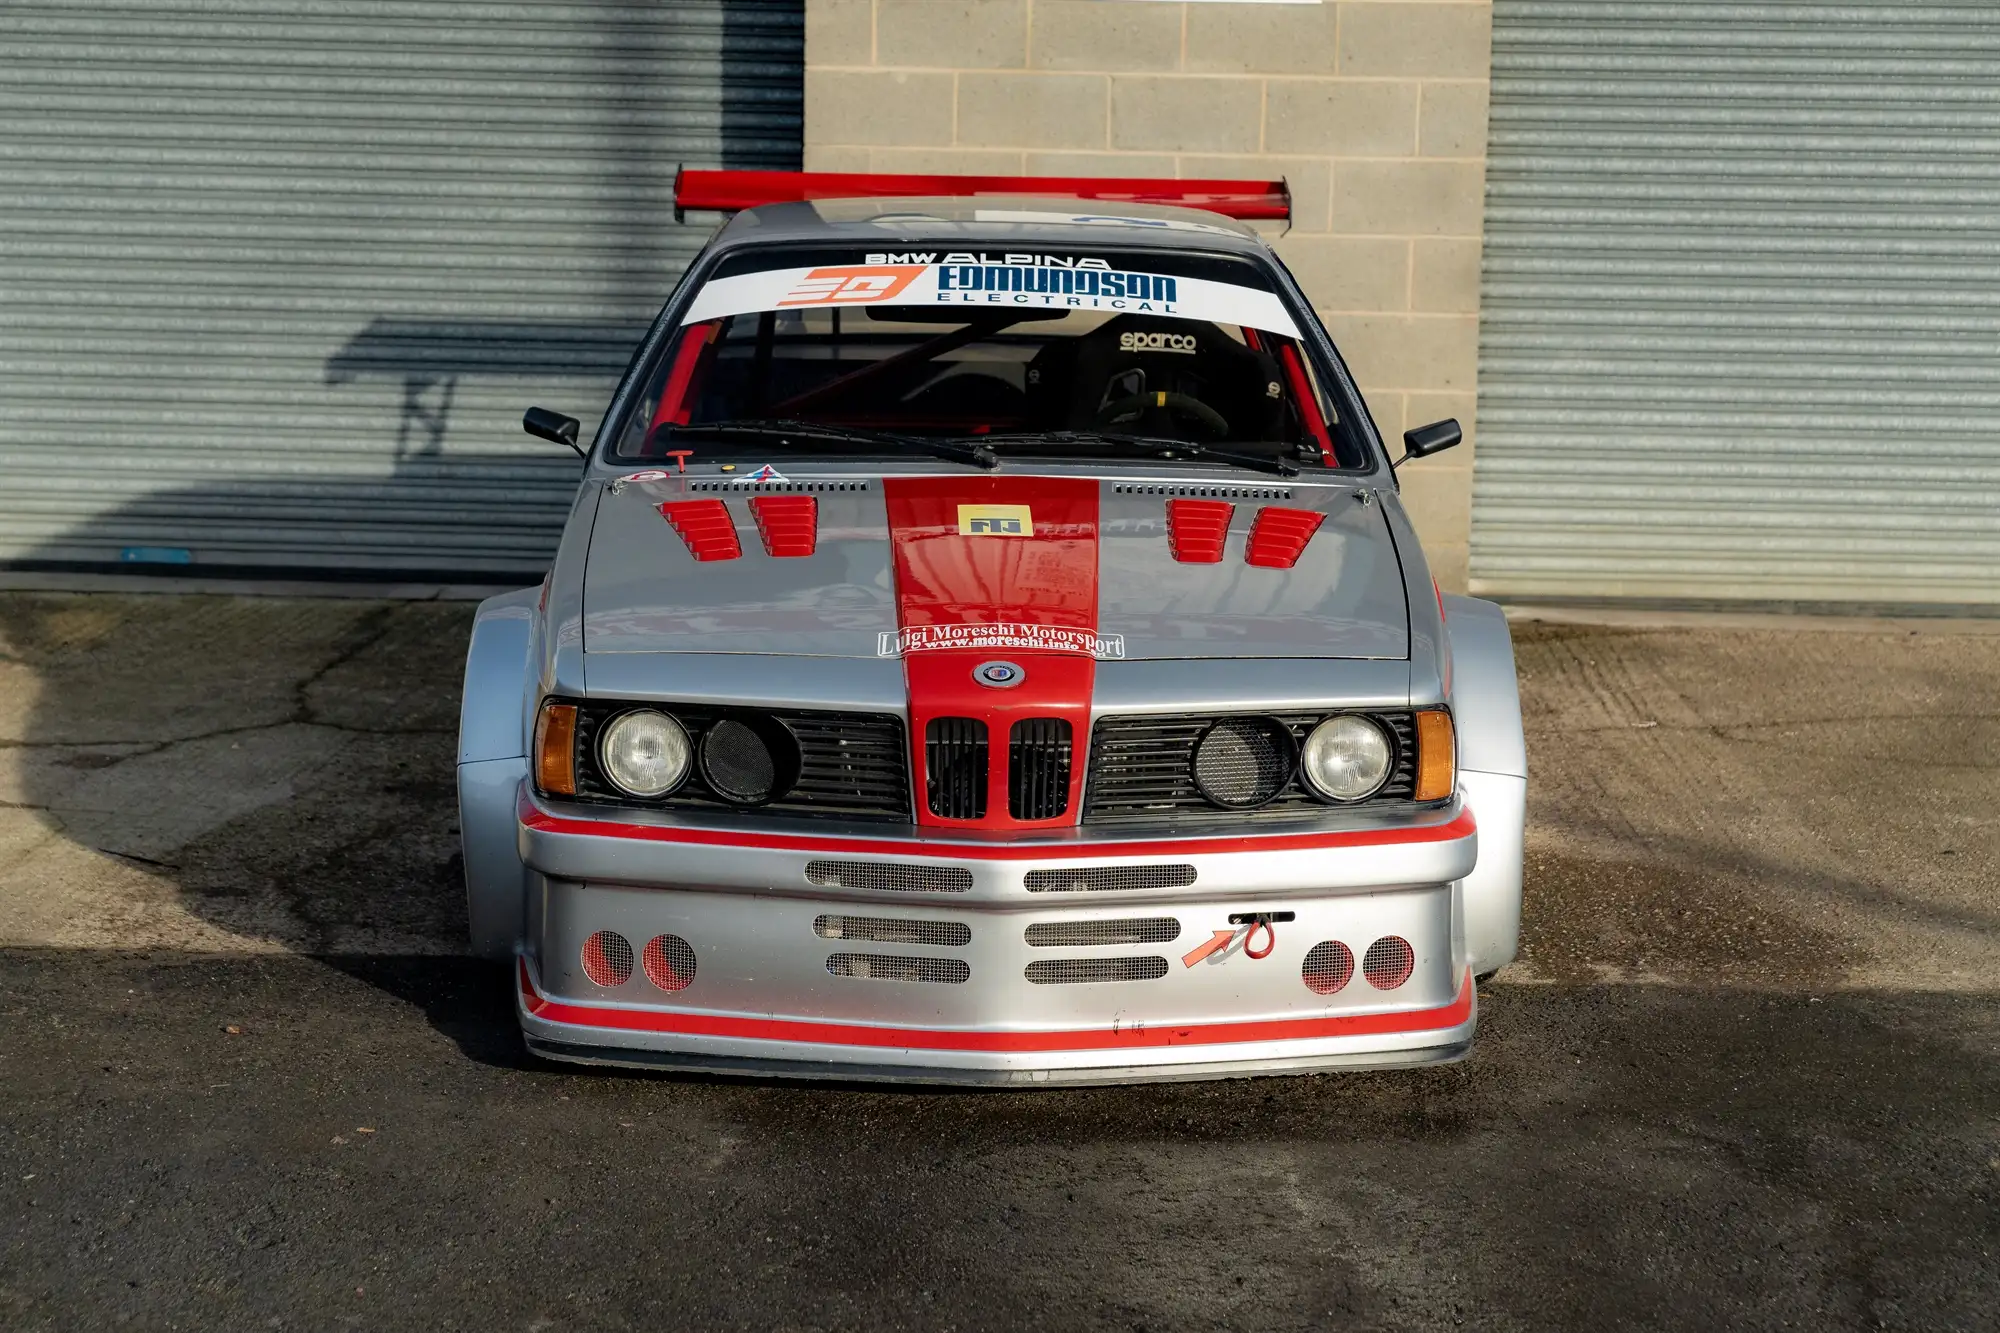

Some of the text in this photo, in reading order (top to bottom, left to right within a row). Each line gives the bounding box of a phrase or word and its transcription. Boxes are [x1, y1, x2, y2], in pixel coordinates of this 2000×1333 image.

[865, 252, 1112, 270] BMW ALPINA
[938, 265, 1177, 303] EDMUNDSON
[937, 293, 1178, 314] ELECTRICAL
[1120, 332, 1196, 353] sparco
[881, 624, 1121, 656] Luigi Moreschi Motorsport
[925, 635, 1080, 650] www.moreschi.info
